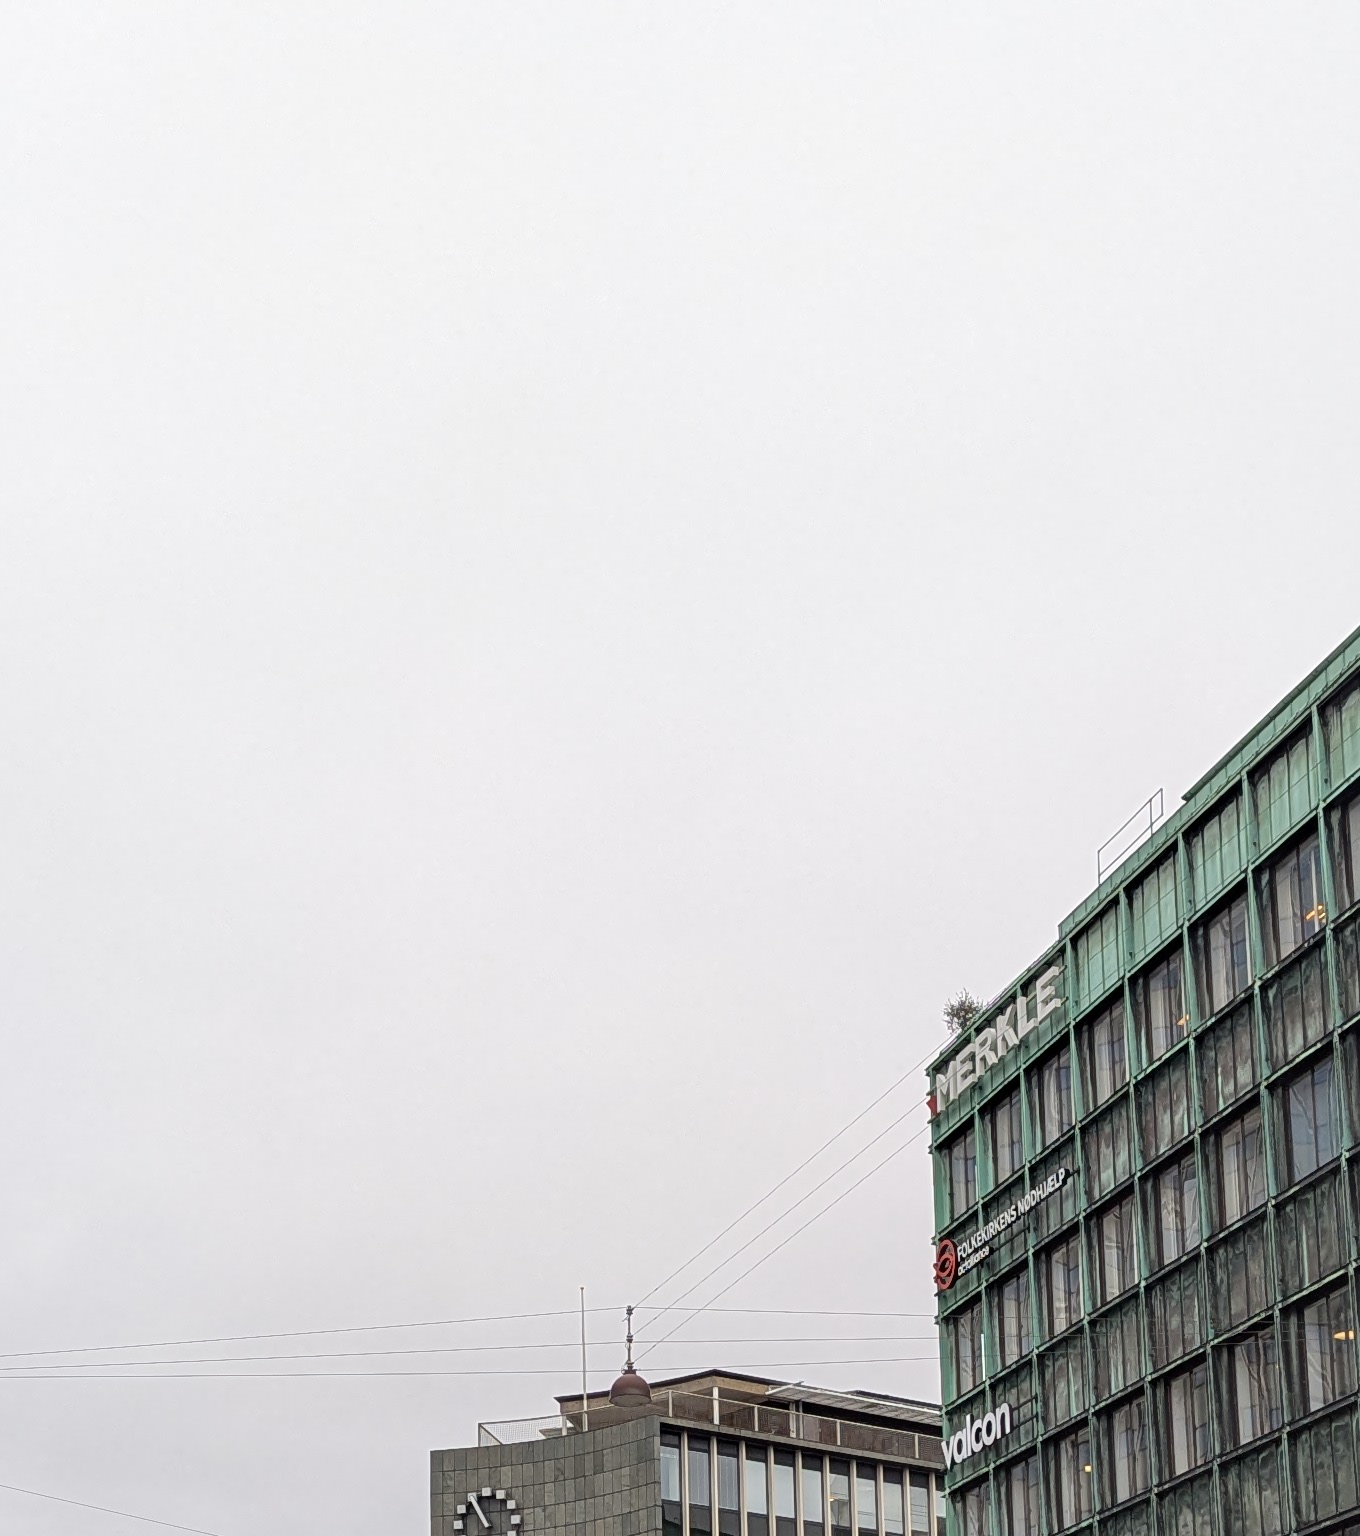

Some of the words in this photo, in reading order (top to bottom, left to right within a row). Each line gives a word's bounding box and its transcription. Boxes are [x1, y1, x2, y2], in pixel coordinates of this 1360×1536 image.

[935, 966, 1062, 1113] MERKLE
[957, 1205, 1016, 1262] FOLKEKIRKENS
[1017, 1168, 1065, 1216] NØDHJÆLP
[941, 1402, 1011, 1470] valcon
